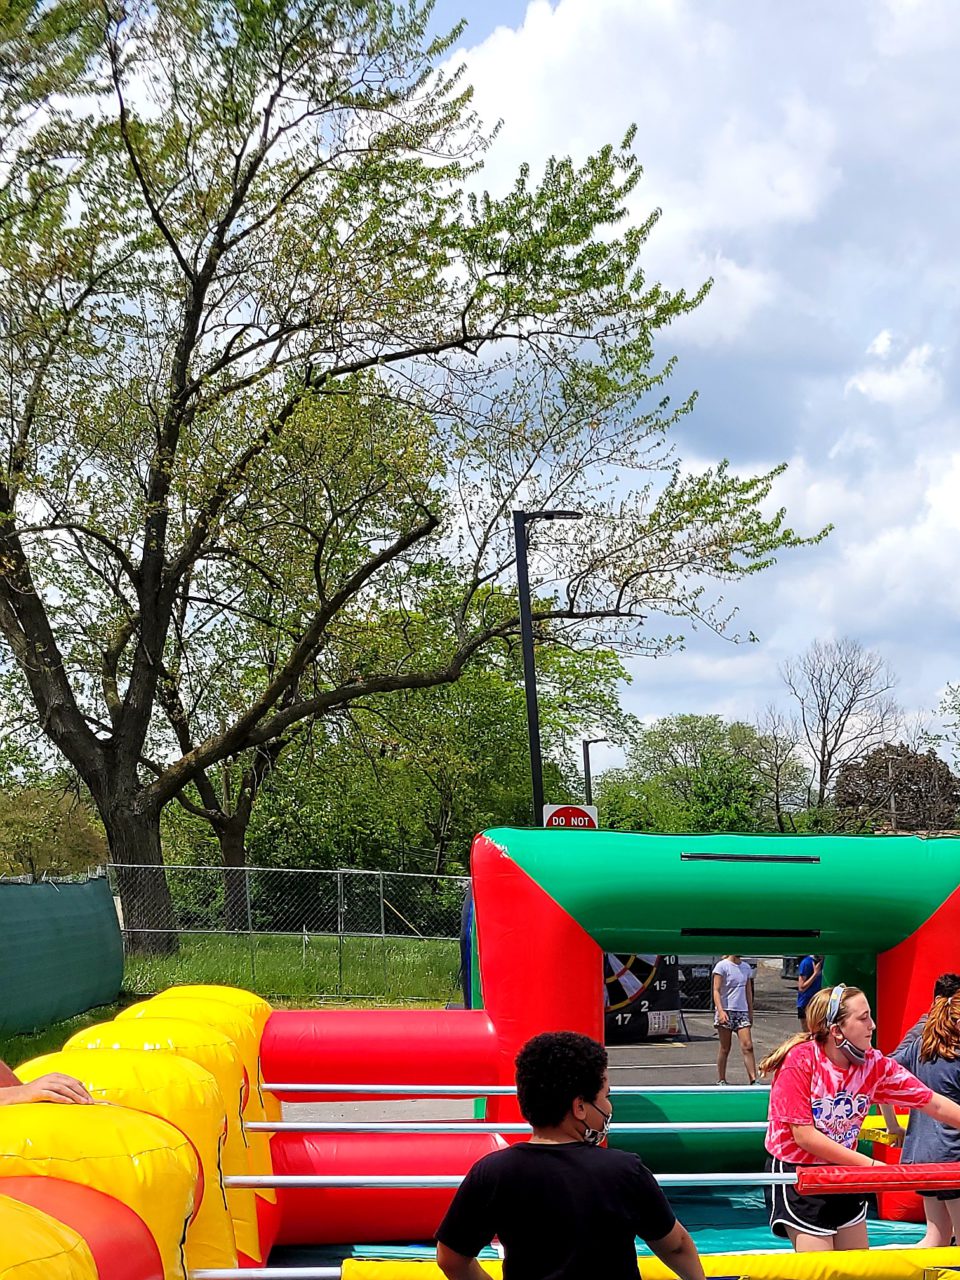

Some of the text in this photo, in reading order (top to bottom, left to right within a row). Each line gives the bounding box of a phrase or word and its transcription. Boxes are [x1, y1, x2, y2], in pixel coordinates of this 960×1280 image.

[552, 816, 590, 826] DO NOT
[663, 955, 676, 965] 10
[653, 980, 667, 991] 15
[640, 1000, 649, 1012] 2
[615, 1013, 632, 1026] 17
